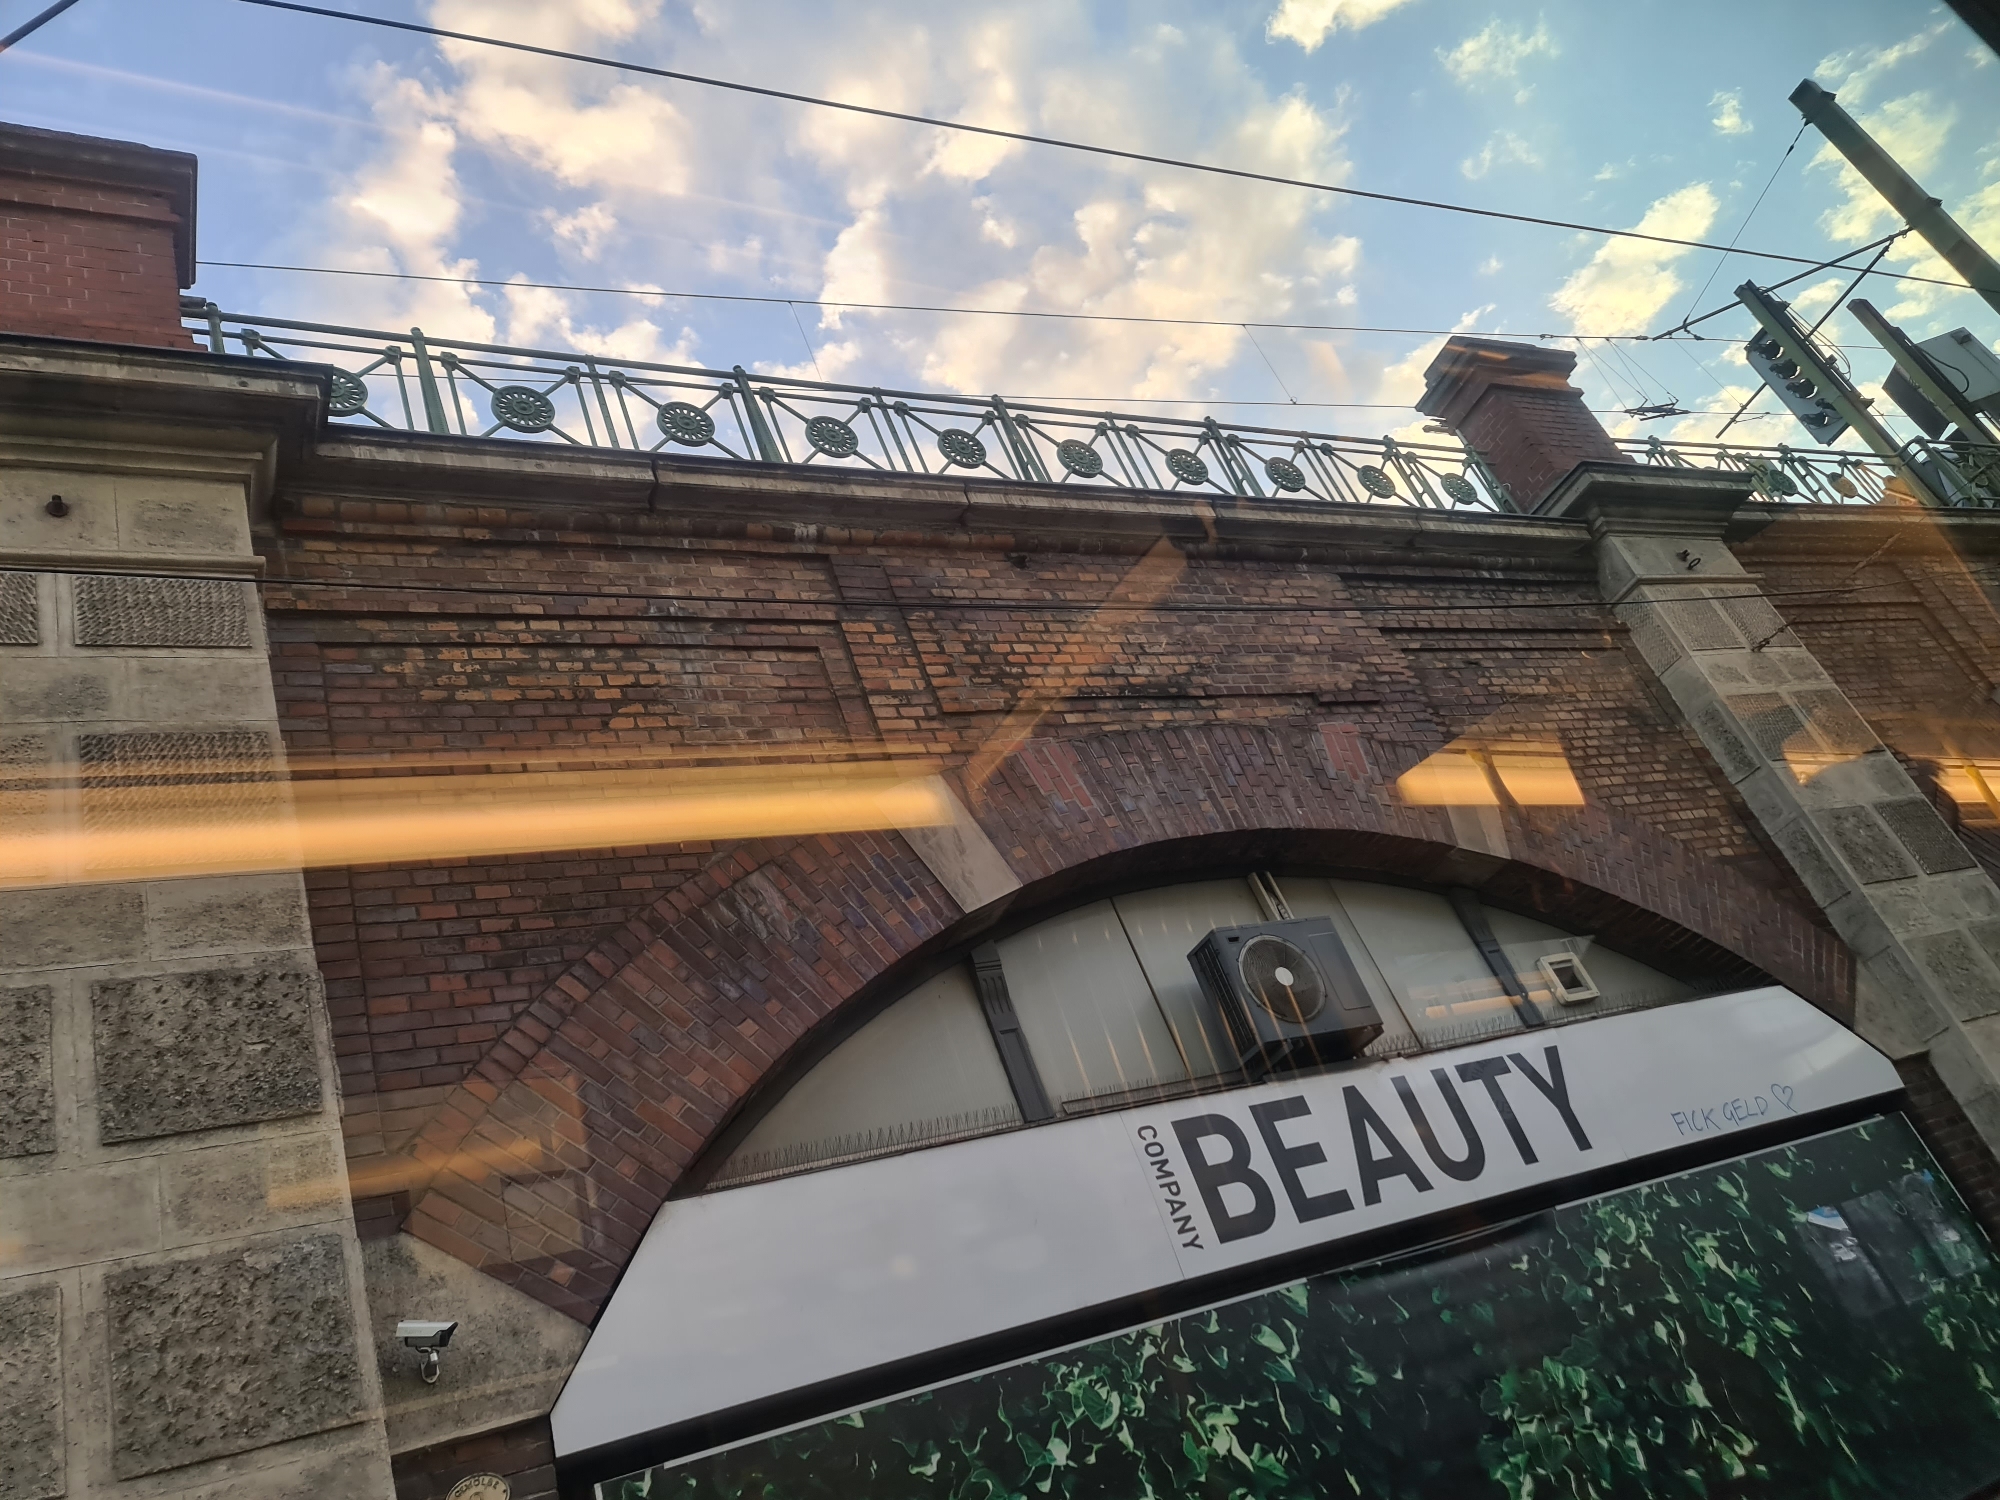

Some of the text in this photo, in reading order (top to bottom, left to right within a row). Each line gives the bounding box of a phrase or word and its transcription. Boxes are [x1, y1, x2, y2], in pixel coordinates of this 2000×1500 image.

[1170, 1045, 1593, 1245] BEAUTY
[1671, 1096, 1768, 1136] FICK GELD
[1137, 1124, 1204, 1250] COMPANY
